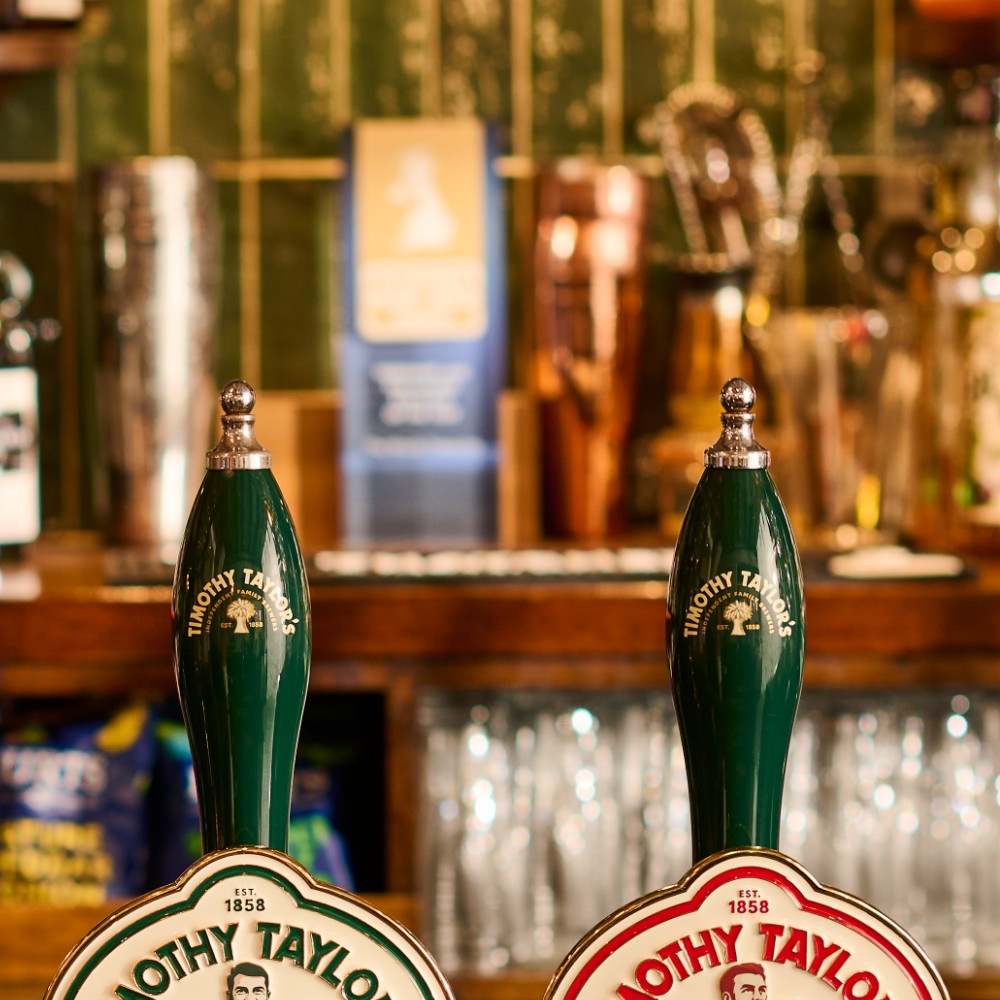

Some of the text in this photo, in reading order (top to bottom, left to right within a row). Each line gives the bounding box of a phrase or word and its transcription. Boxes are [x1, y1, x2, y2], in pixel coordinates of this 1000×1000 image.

[187, 568, 300, 637] TIMOTHY TAYLOR'S
[683, 570, 796, 638] TIMOTHY TAYLOR'S
[234, 888, 257, 896] EST.
[738, 890, 761, 898] EST.
[224, 899, 265, 912] 1858
[728, 900, 769, 914] 1858
